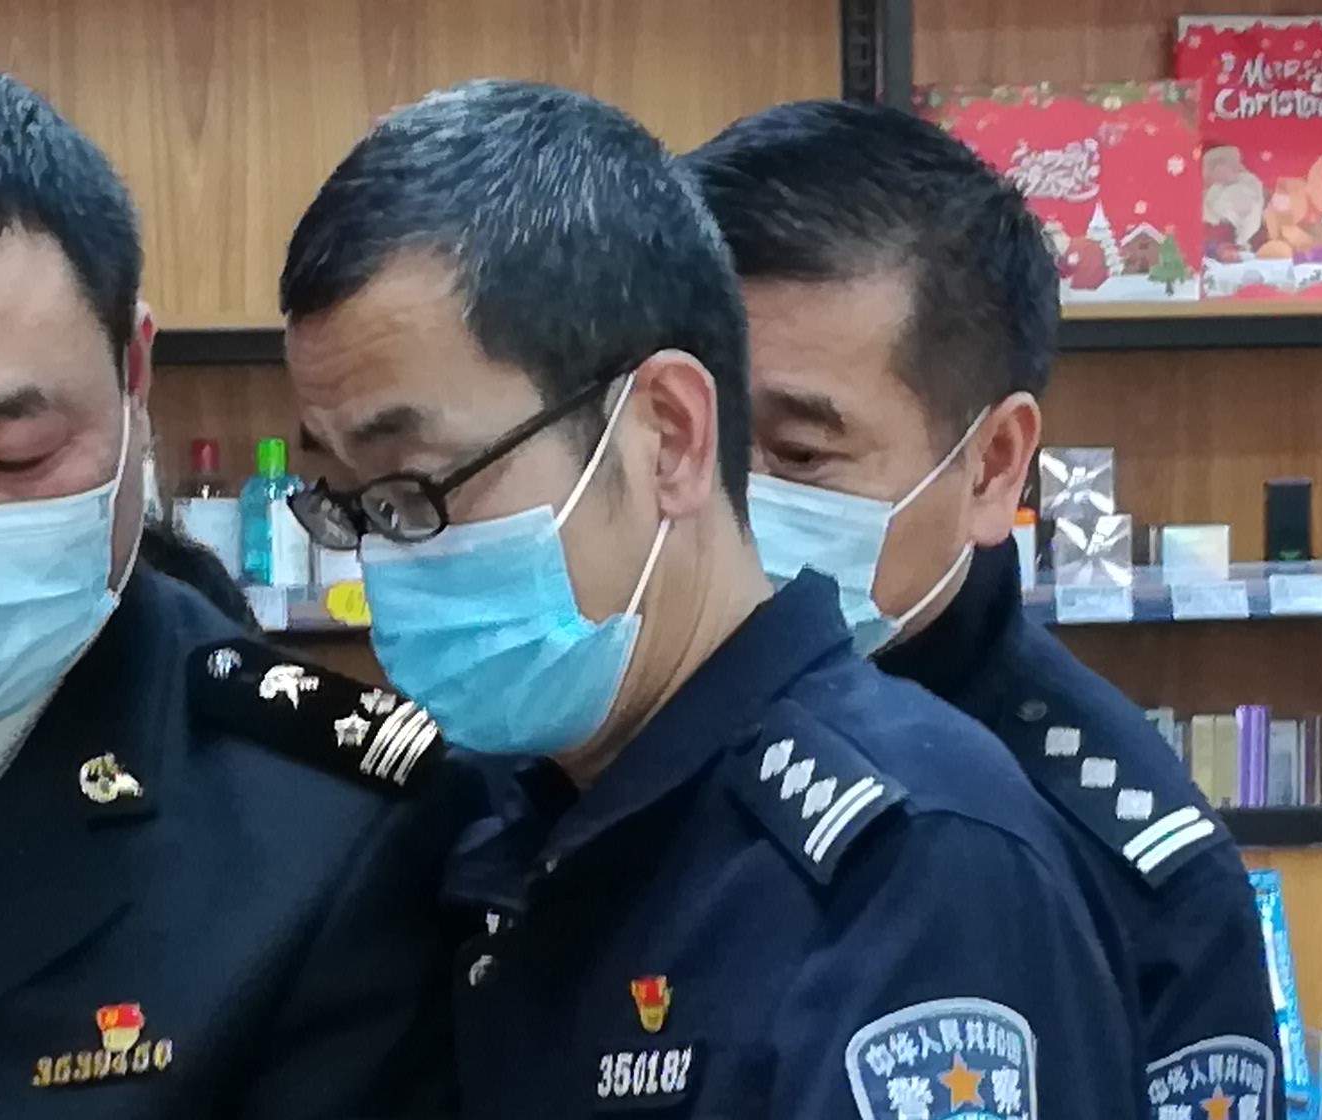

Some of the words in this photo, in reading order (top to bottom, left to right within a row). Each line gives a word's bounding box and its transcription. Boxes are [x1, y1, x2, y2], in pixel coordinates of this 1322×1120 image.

[864, 1016, 1022, 1078] 中华人民共和国
